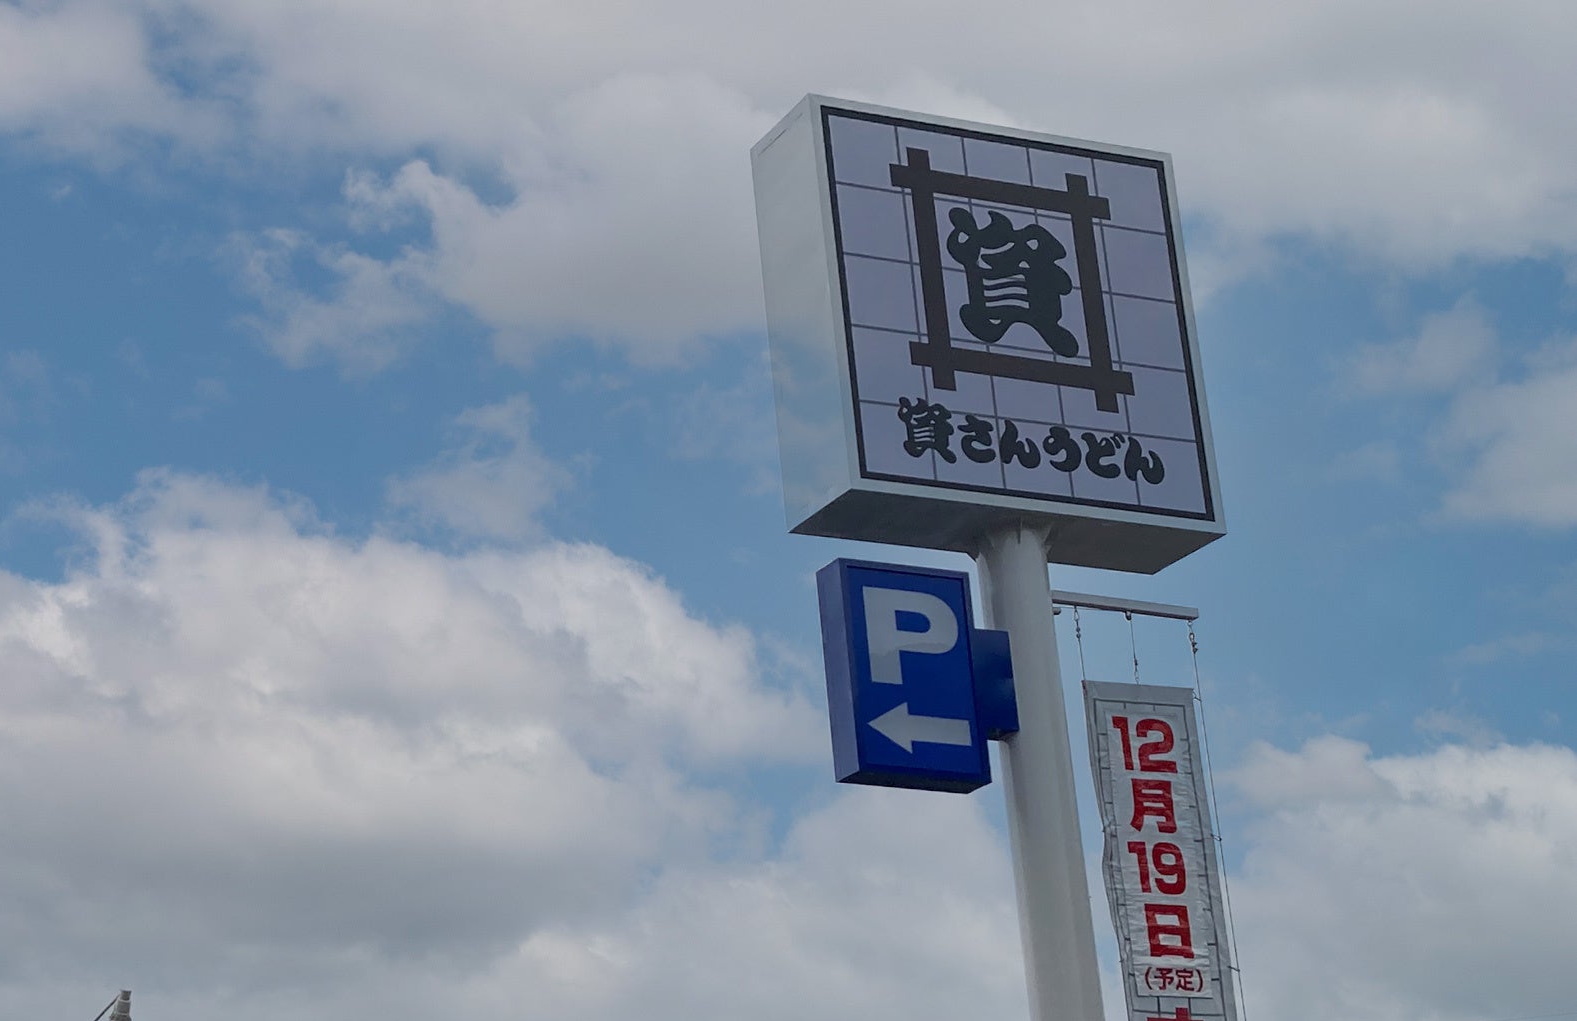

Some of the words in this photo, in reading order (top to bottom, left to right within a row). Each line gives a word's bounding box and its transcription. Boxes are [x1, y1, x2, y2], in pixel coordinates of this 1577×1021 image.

[946, 206, 1080, 358] 資
[896, 396, 1166, 486] 資さんうどん
[862, 585, 959, 685] P
